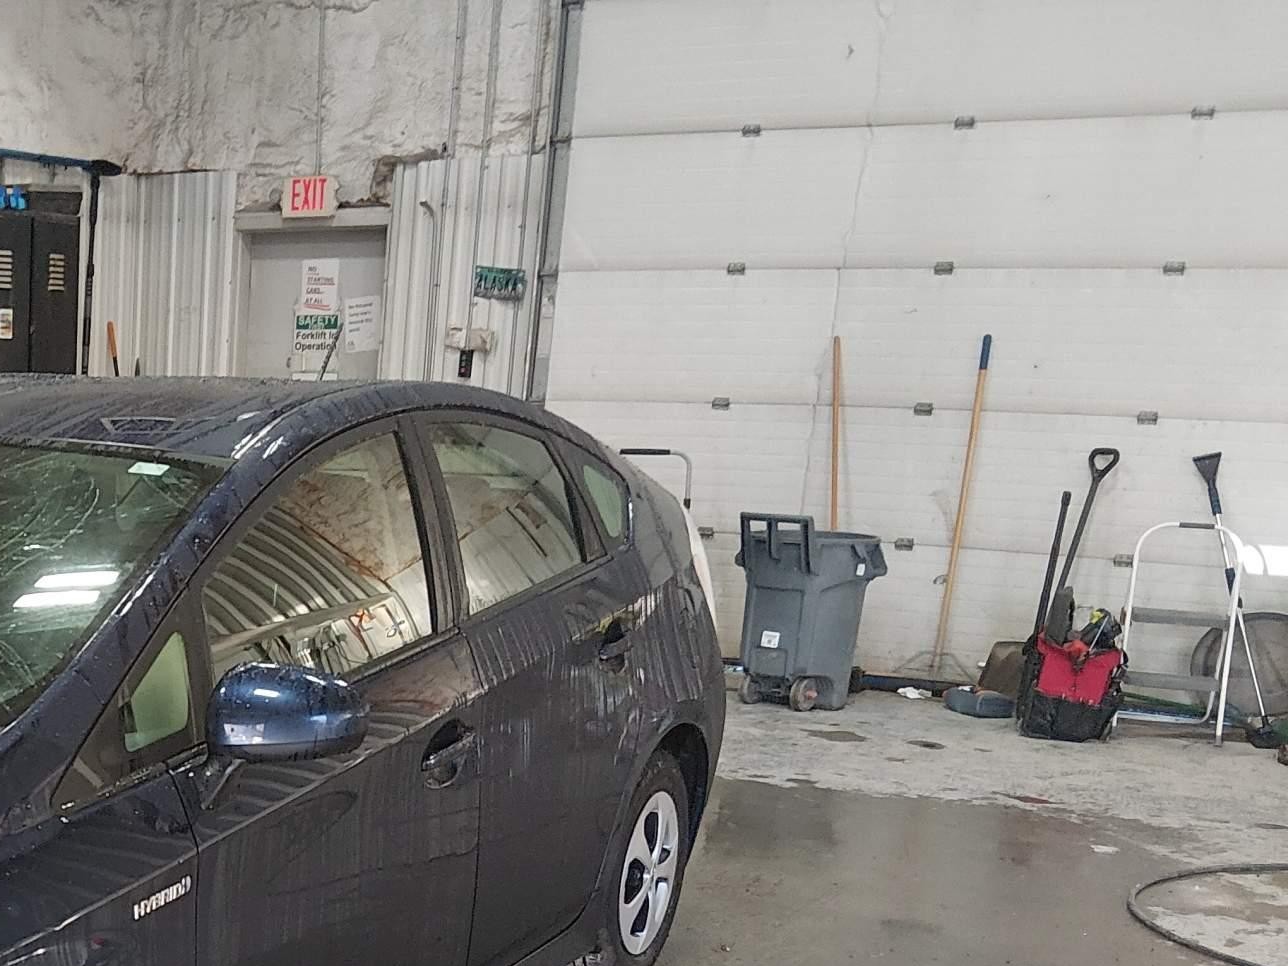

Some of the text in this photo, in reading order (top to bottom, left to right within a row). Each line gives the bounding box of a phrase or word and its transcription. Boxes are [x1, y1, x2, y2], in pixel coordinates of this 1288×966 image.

[291, 178, 327, 210] EXIT
[475, 273, 520, 293] ALASKA
[298, 315, 337, 326] SAFETY
[296, 331, 326, 340] Forklift
[133, 878, 186, 920] HYBRID
